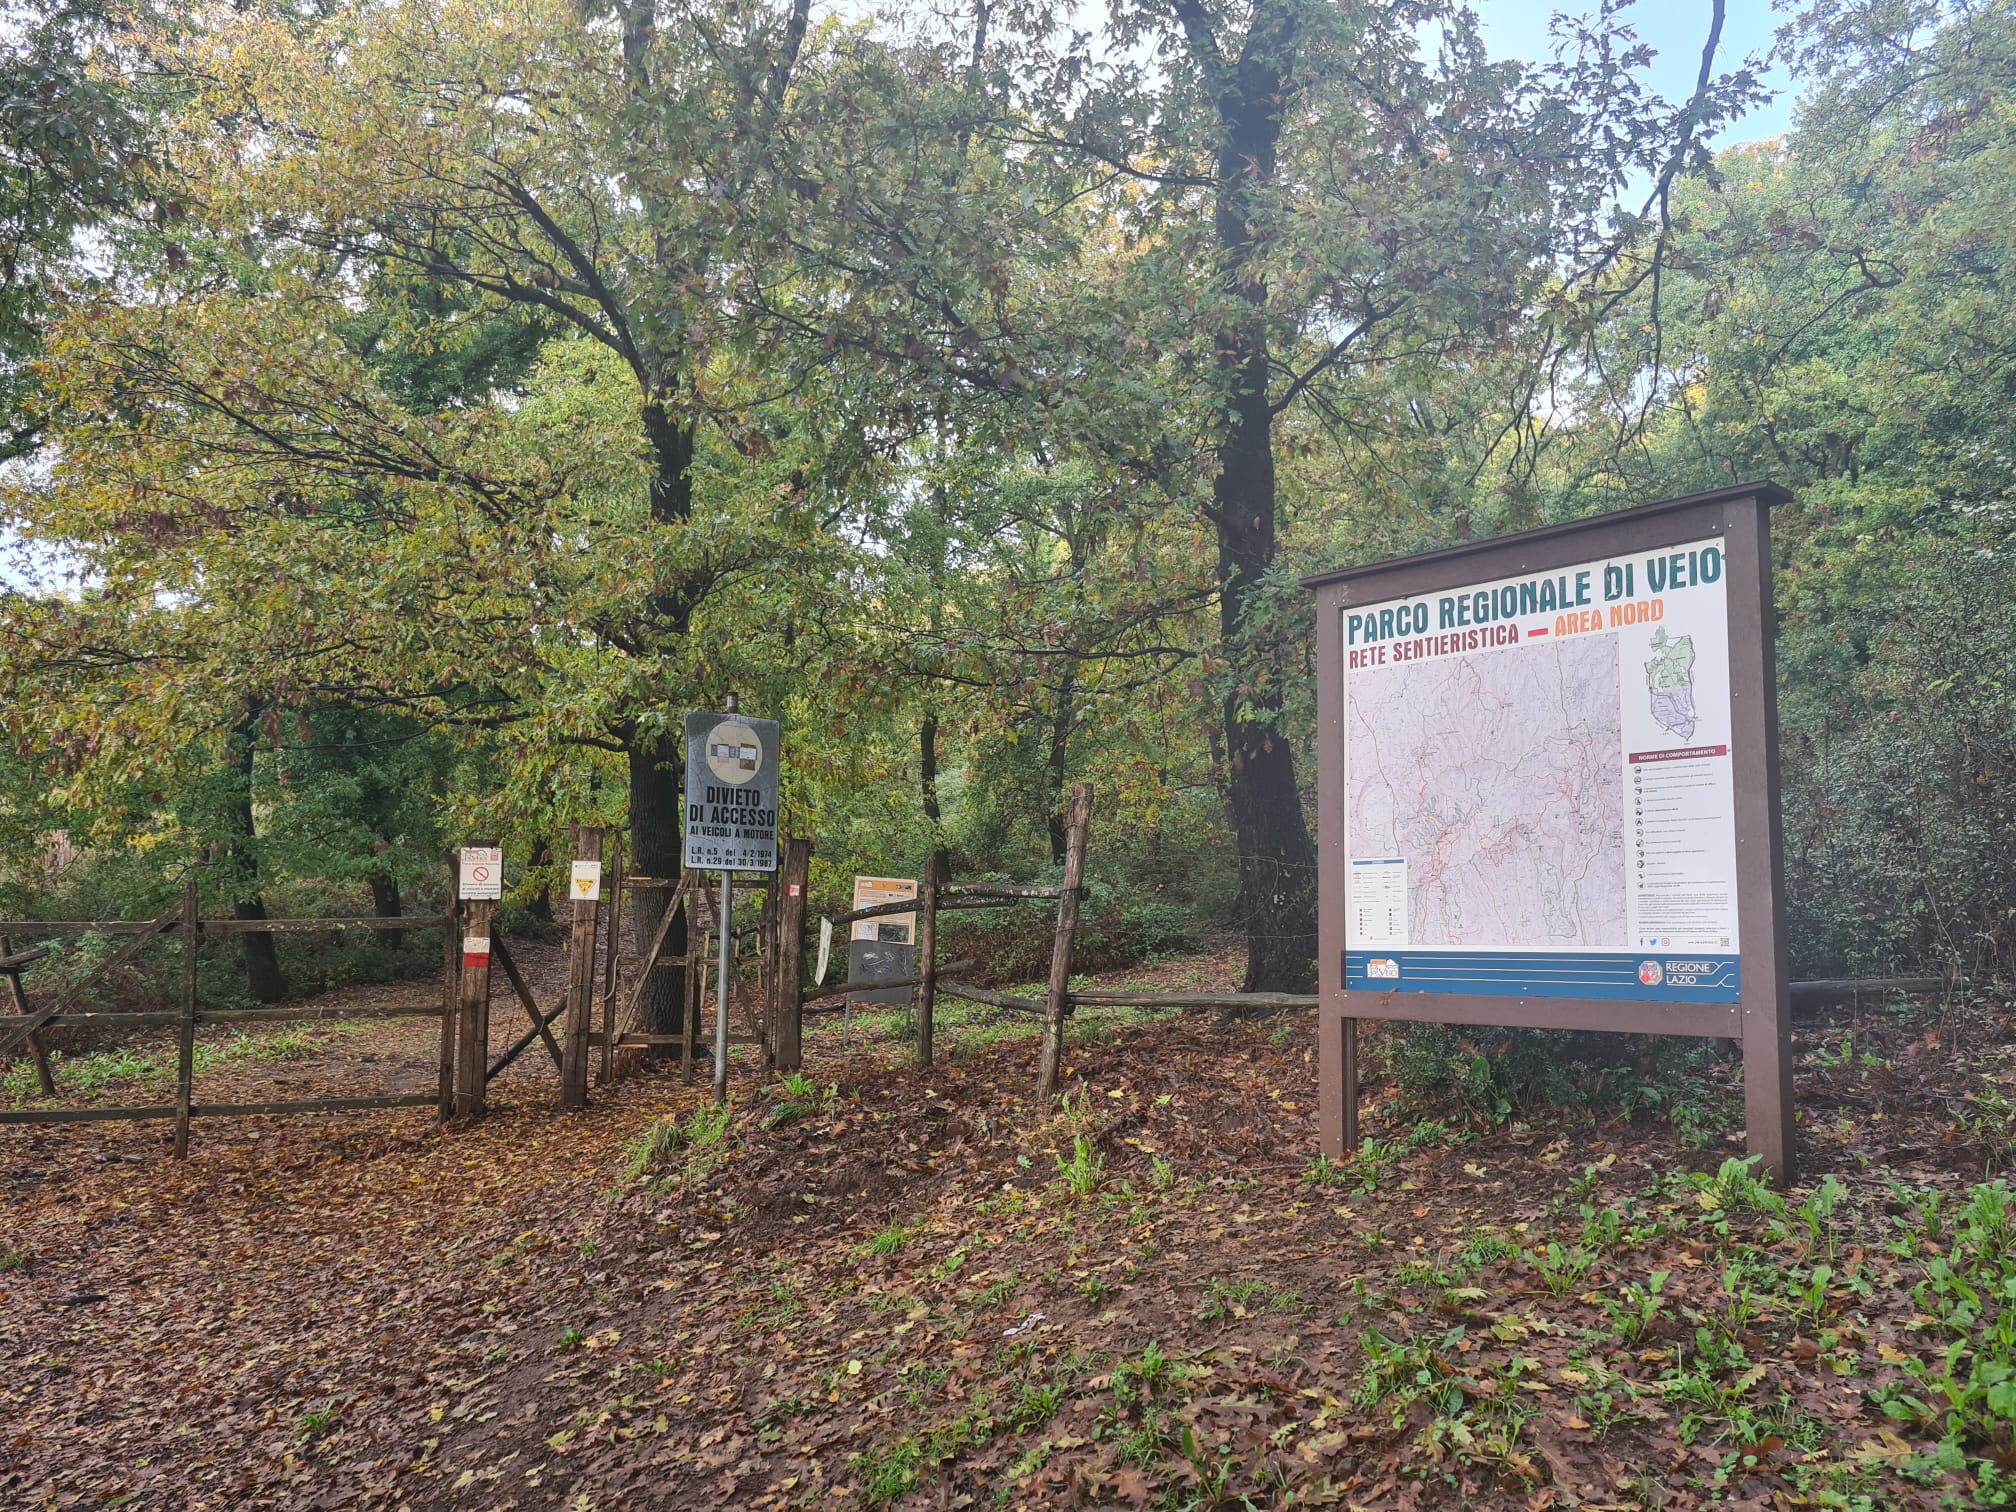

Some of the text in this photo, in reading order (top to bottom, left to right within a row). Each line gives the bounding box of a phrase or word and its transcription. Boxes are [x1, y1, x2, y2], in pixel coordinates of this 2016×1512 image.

[1348, 547, 1721, 645] PARCO REGIONALE DI VEIO
[1349, 598, 1664, 669] RETE SENTIERISTICA AREA NORD
[1665, 748, 1716, 759] COMPORTAMENTO
[706, 786, 760, 807] DIVIETO
[689, 804, 775, 827] DI ACCESSO
[690, 825, 774, 840] AI VEICOLI A MOTORE
[691, 846, 772, 858] L.R. n.5 del 4/2/1974
[706, 857, 722, 865] n.29
[724, 858, 736, 866] del
[738, 859, 772, 868] 30/3/1987
[1665, 962, 1711, 973] REGIONE
[1666, 975, 1697, 984] LAZIO
